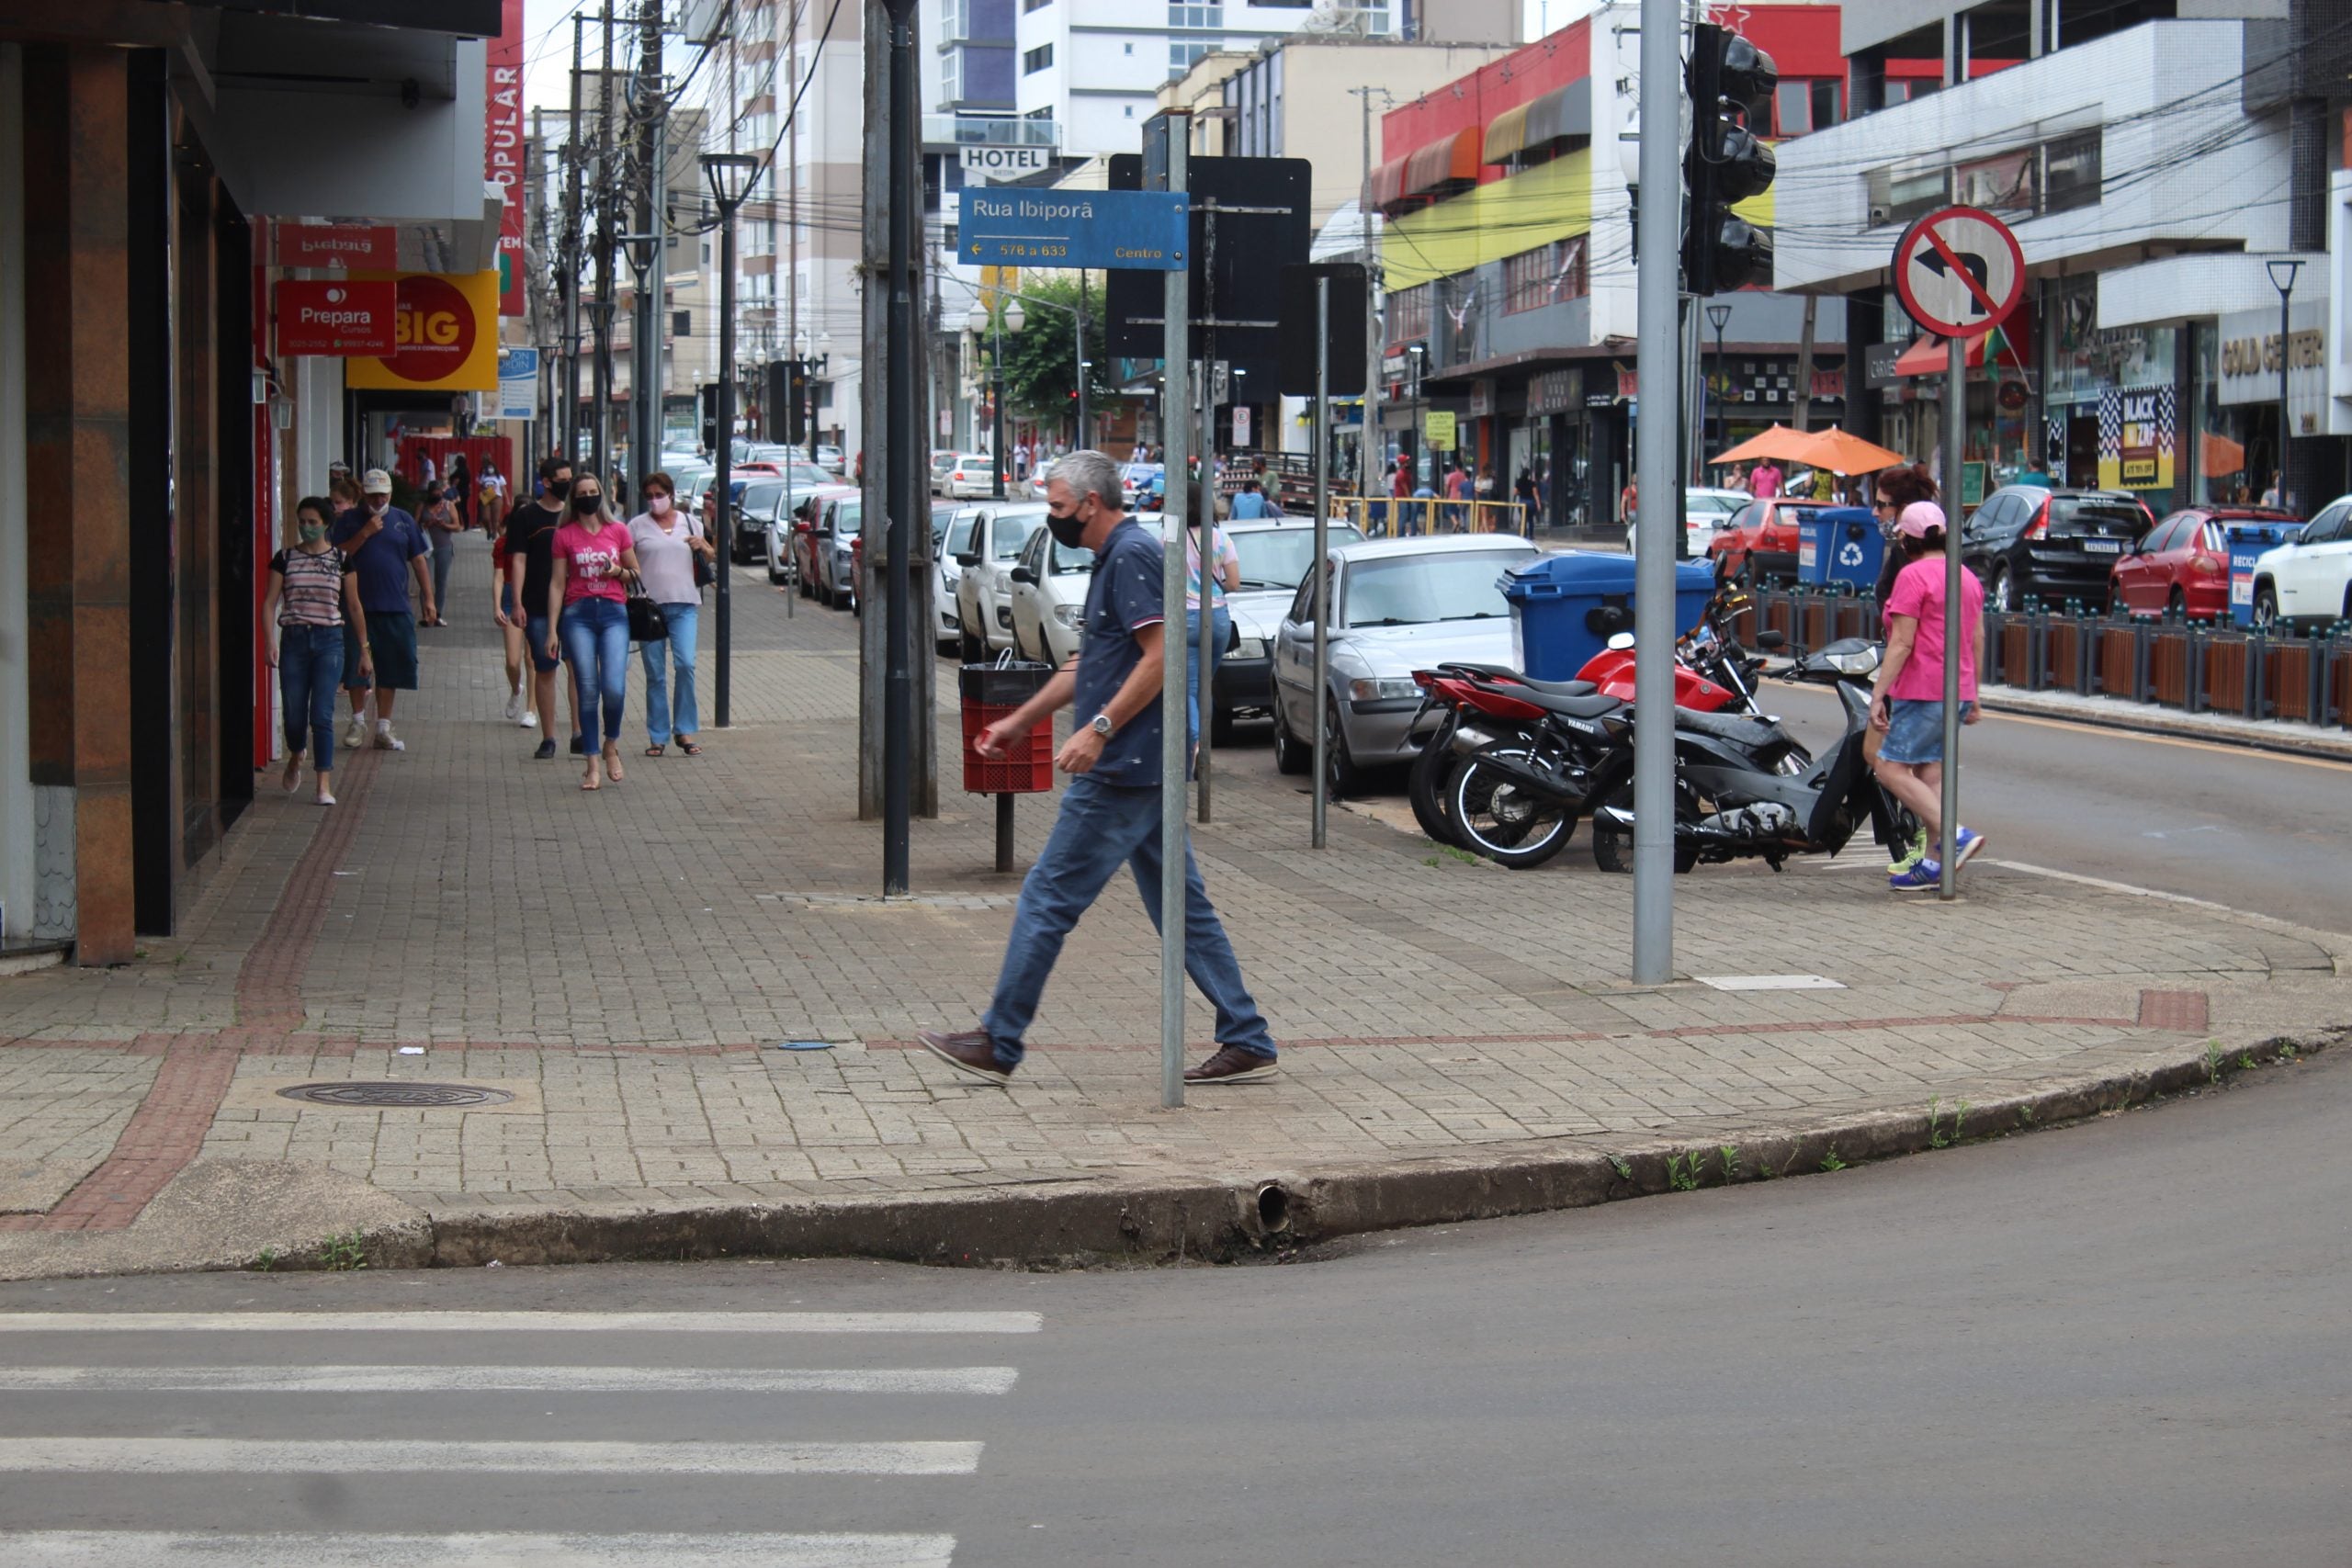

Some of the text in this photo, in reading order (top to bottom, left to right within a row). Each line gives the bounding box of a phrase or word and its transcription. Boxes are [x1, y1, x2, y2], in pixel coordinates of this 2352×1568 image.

[967, 150, 1041, 168] HOTEL
[973, 199, 1093, 220] Rua Ibiporã
[1029, 248, 1037, 256] a
[1041, 244, 1067, 256] 633
[1115, 247, 1162, 258] Centro
[300, 308, 371, 328] Prepara
[341, 324, 371, 334] Cursos
[396, 310, 459, 345] BIG
[2222, 337, 2260, 378] GOLD
[2124, 395, 2155, 422] BLACK
[2233, 555, 2256, 568] RECICL
[1567, 719, 1595, 734] YAMAHA
